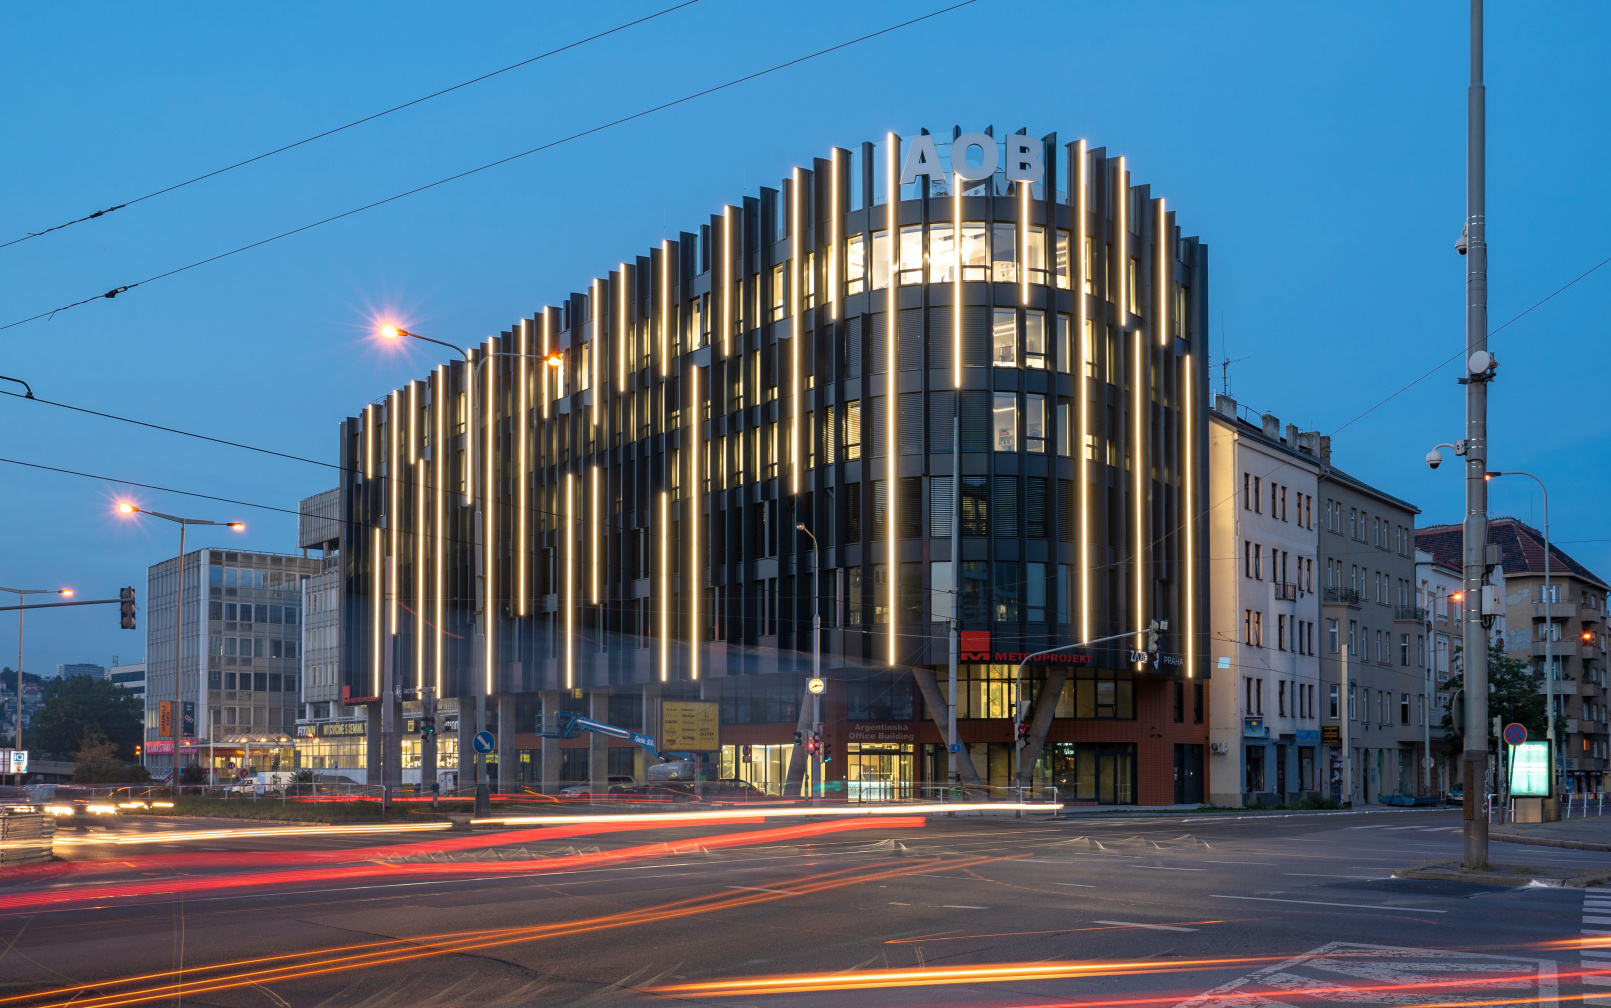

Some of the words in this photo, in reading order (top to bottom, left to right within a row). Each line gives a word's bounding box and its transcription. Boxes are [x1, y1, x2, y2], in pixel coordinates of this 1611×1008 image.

[900, 132, 1045, 184] AOB
[995, 652, 1092, 664] METROPROJEKT
[1163, 655, 1183, 667] PRAHA
[855, 723, 909, 732] Argentinská
[848, 732, 876, 740] Office
[878, 732, 914, 741] Building
